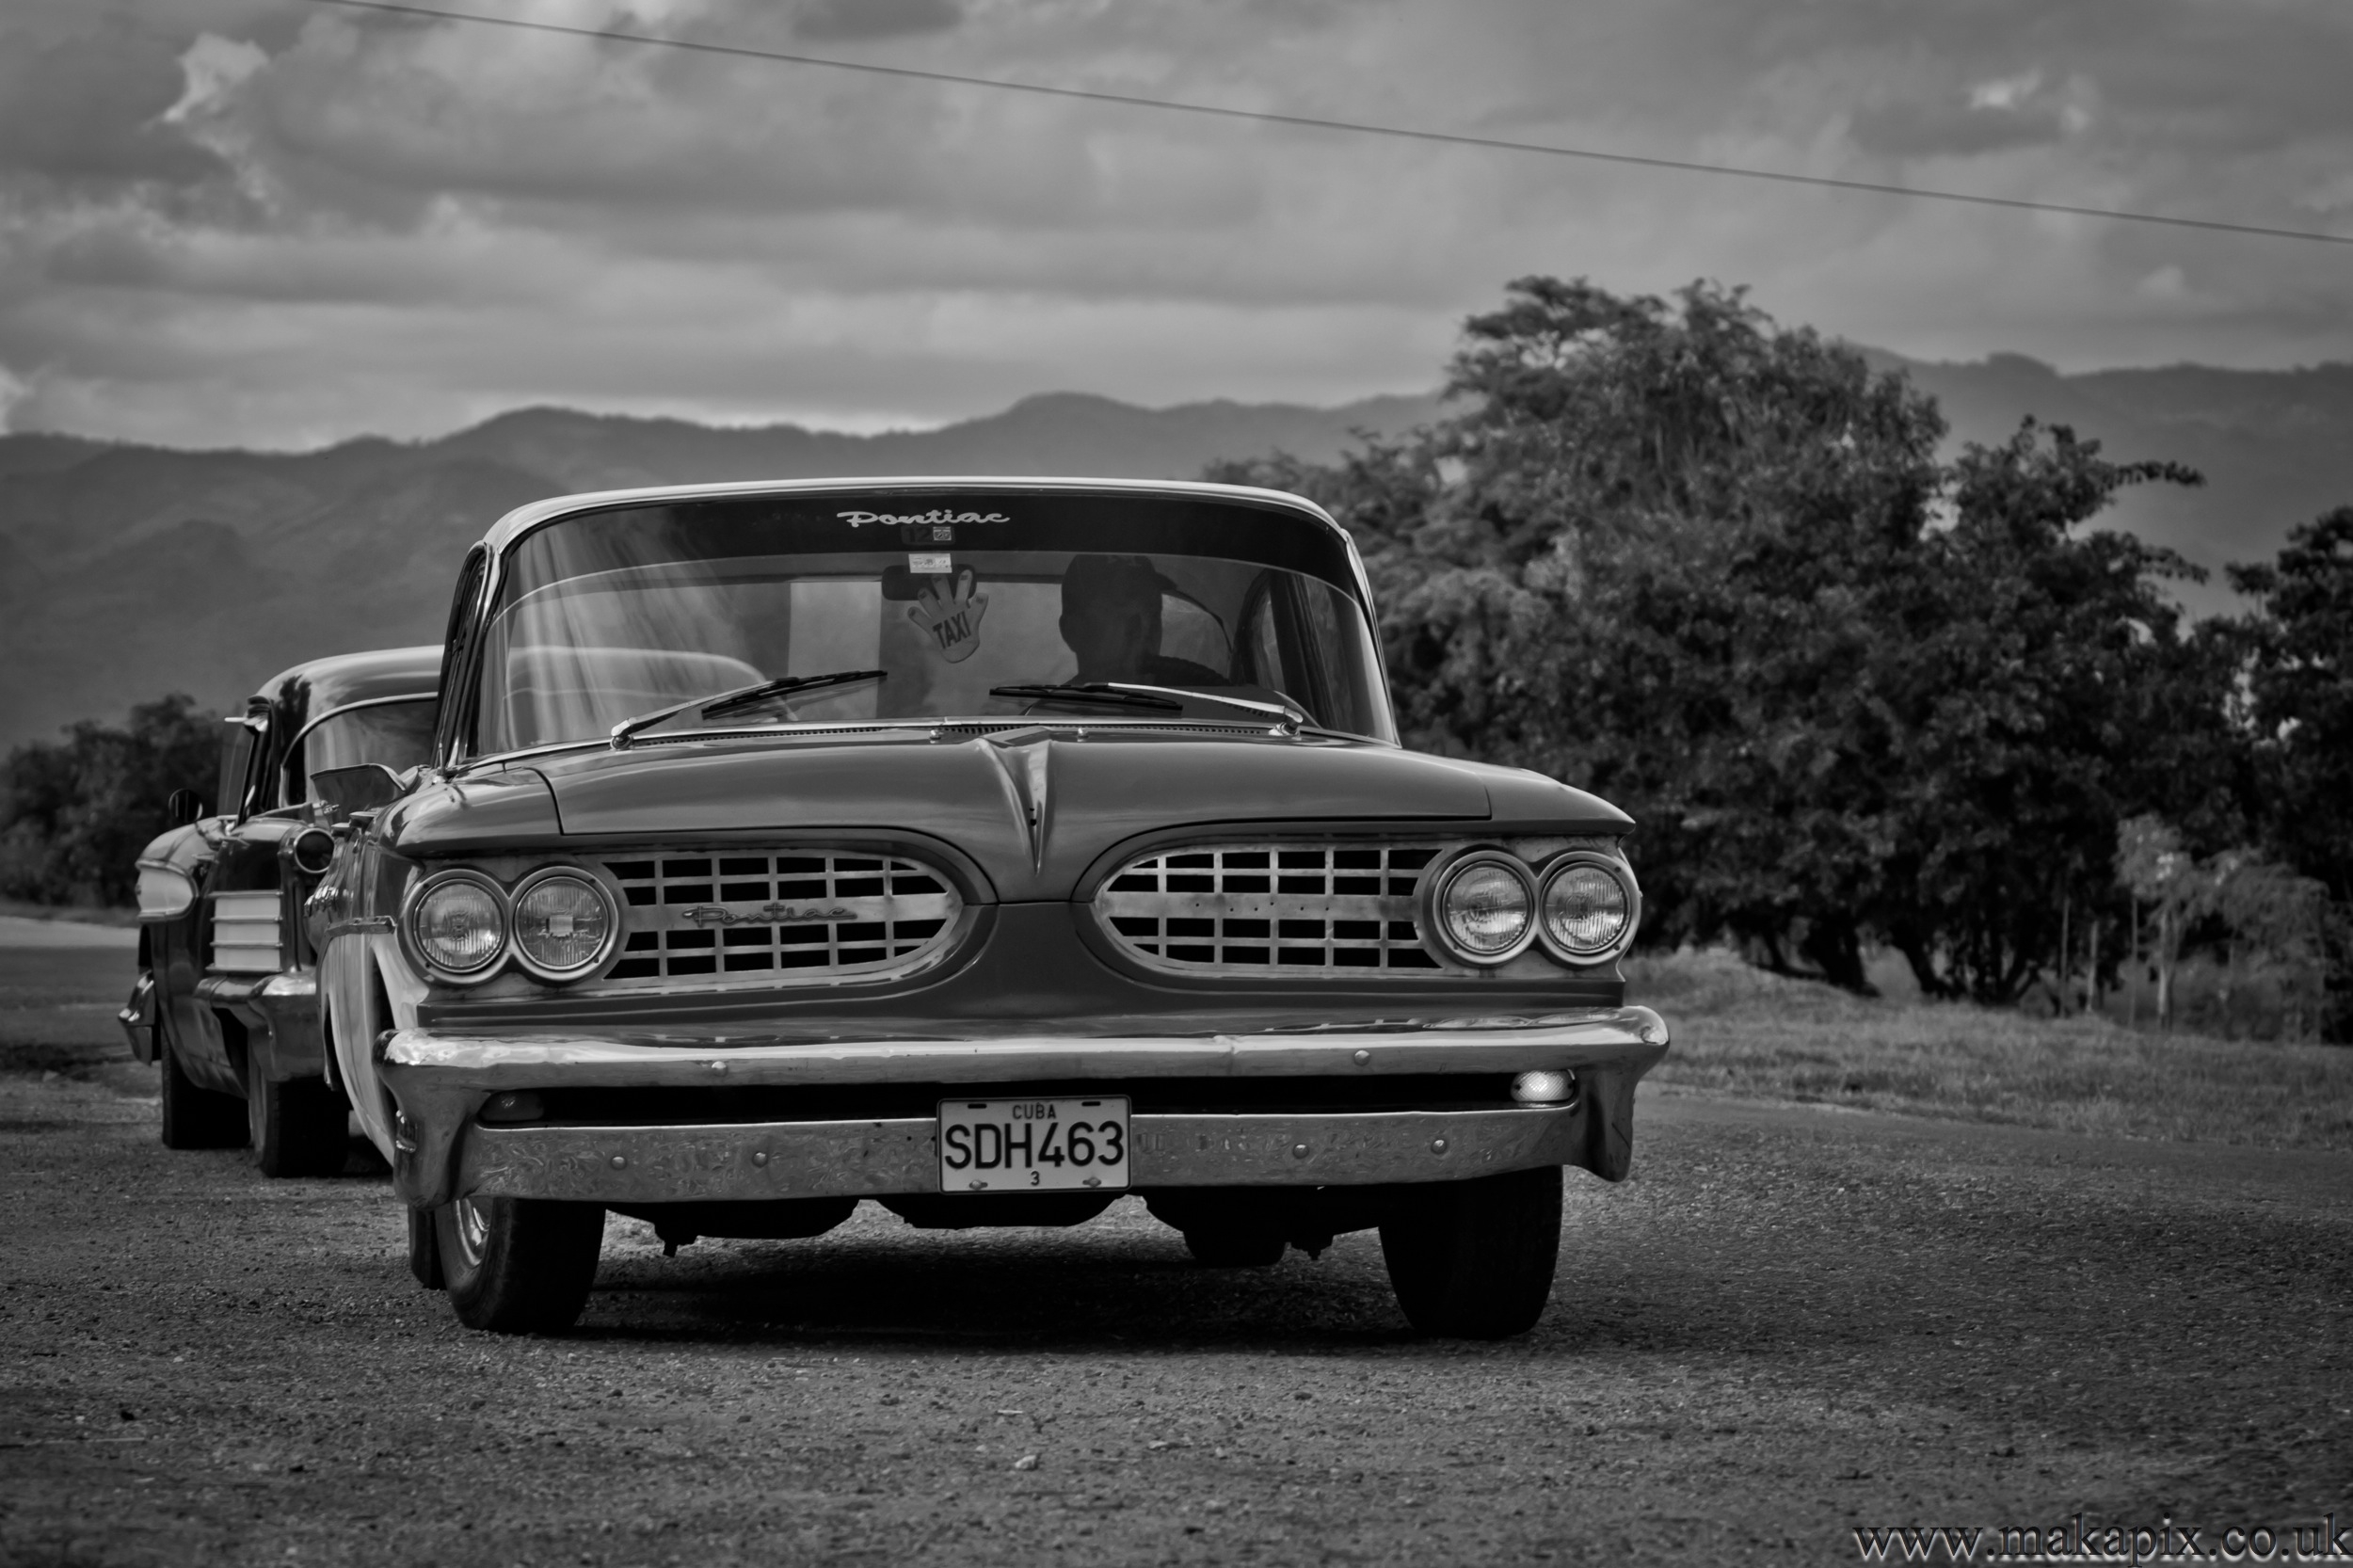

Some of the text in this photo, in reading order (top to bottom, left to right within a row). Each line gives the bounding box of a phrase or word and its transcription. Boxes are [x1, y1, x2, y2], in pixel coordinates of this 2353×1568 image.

[837, 509, 1010, 528] Pontiac
[933, 611, 971, 649] TAXI
[682, 903, 857, 928] Pontiac
[1012, 1104, 1057, 1120] CUBA
[944, 1120, 1124, 1169] SDH463
[1030, 1171, 1040, 1186] 3
